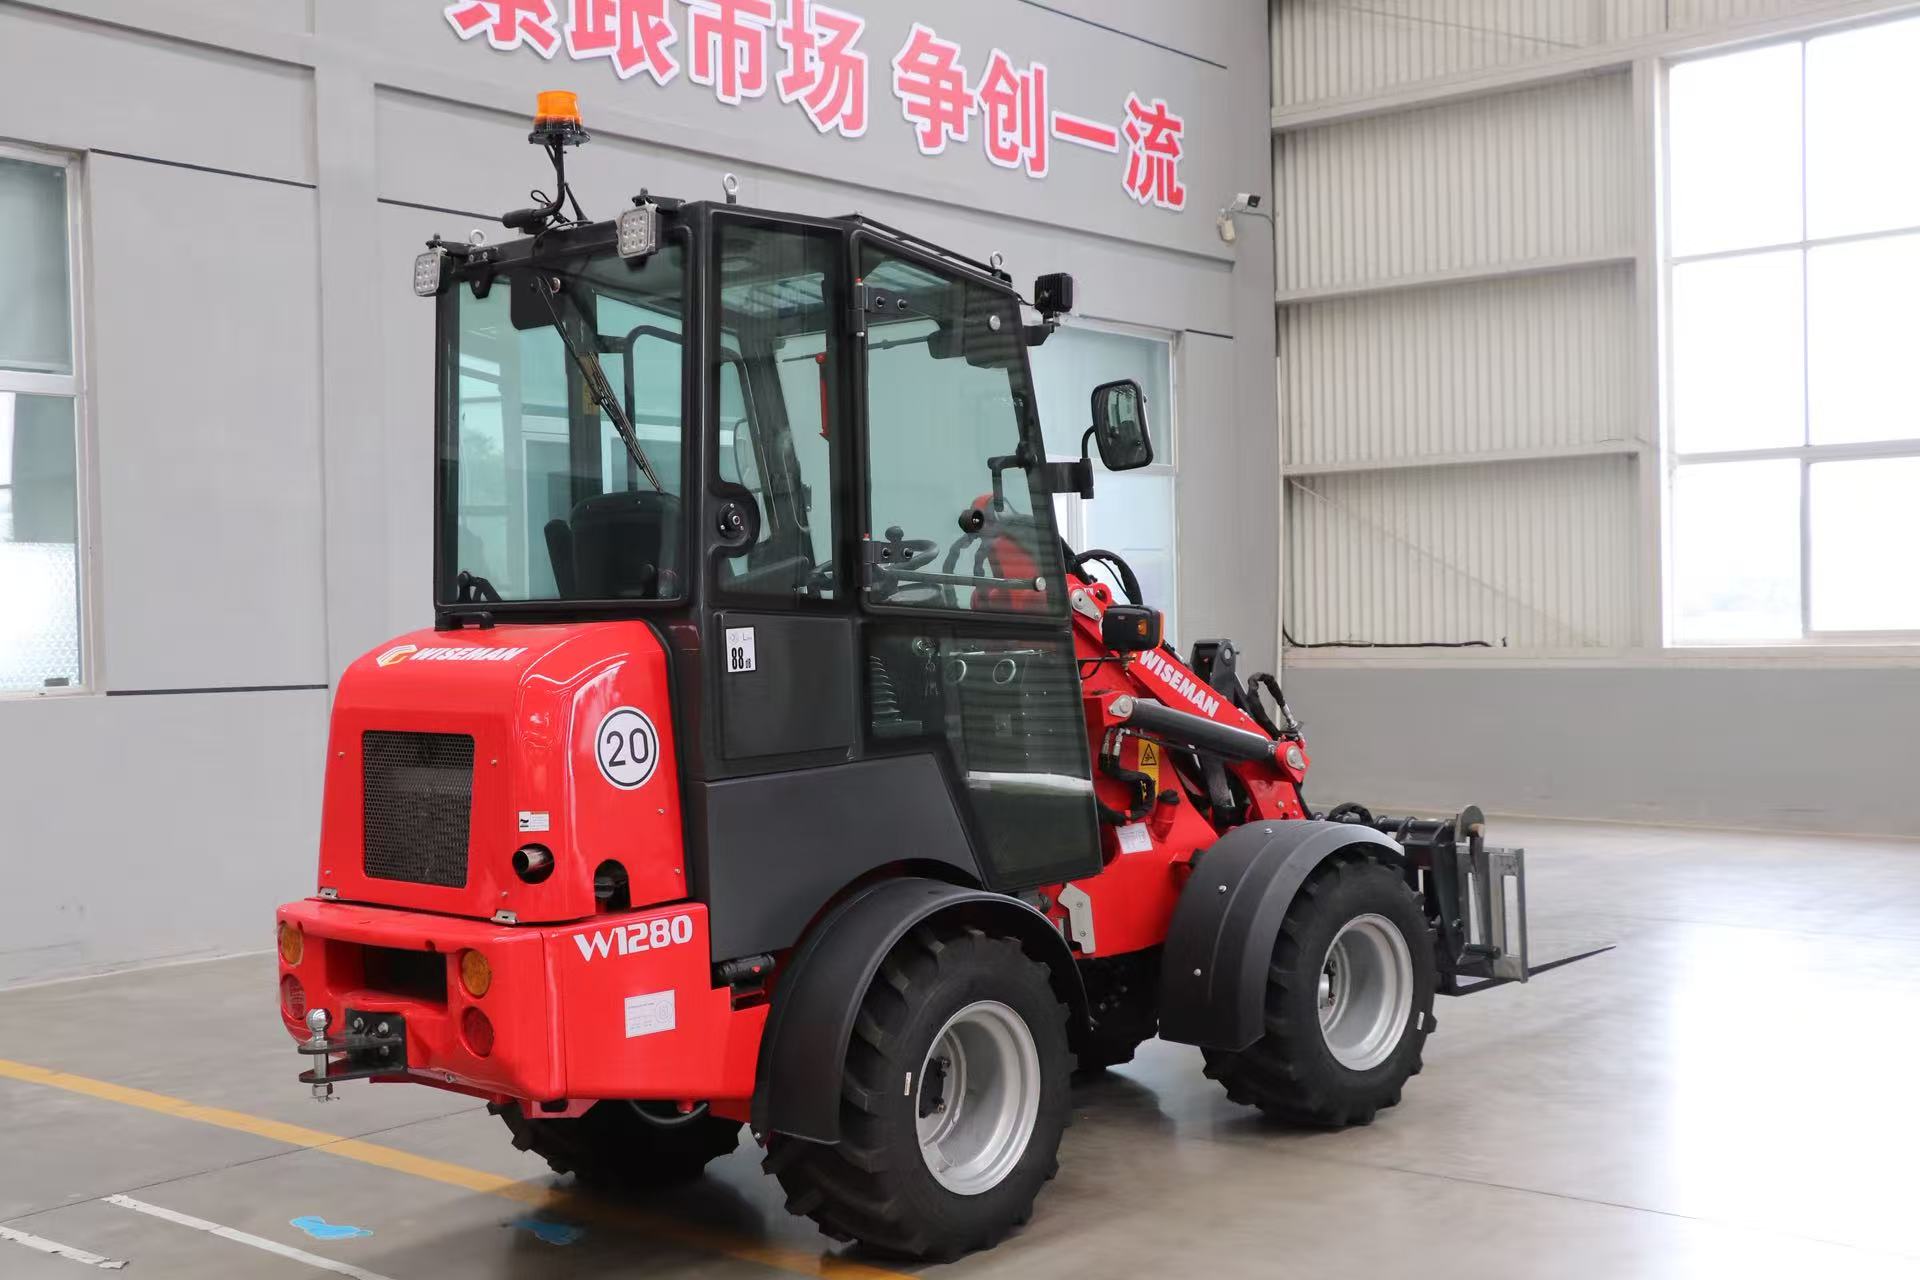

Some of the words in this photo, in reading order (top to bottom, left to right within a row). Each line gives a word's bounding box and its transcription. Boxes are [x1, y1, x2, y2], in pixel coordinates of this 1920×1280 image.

[894, 26, 1186, 208] 争创一流
[409, 647, 528, 661] WISEMAN
[731, 647, 744, 669] 88
[1139, 649, 1220, 718] WISEMAN
[606, 727, 649, 767] 20
[573, 915, 693, 961] W1280
